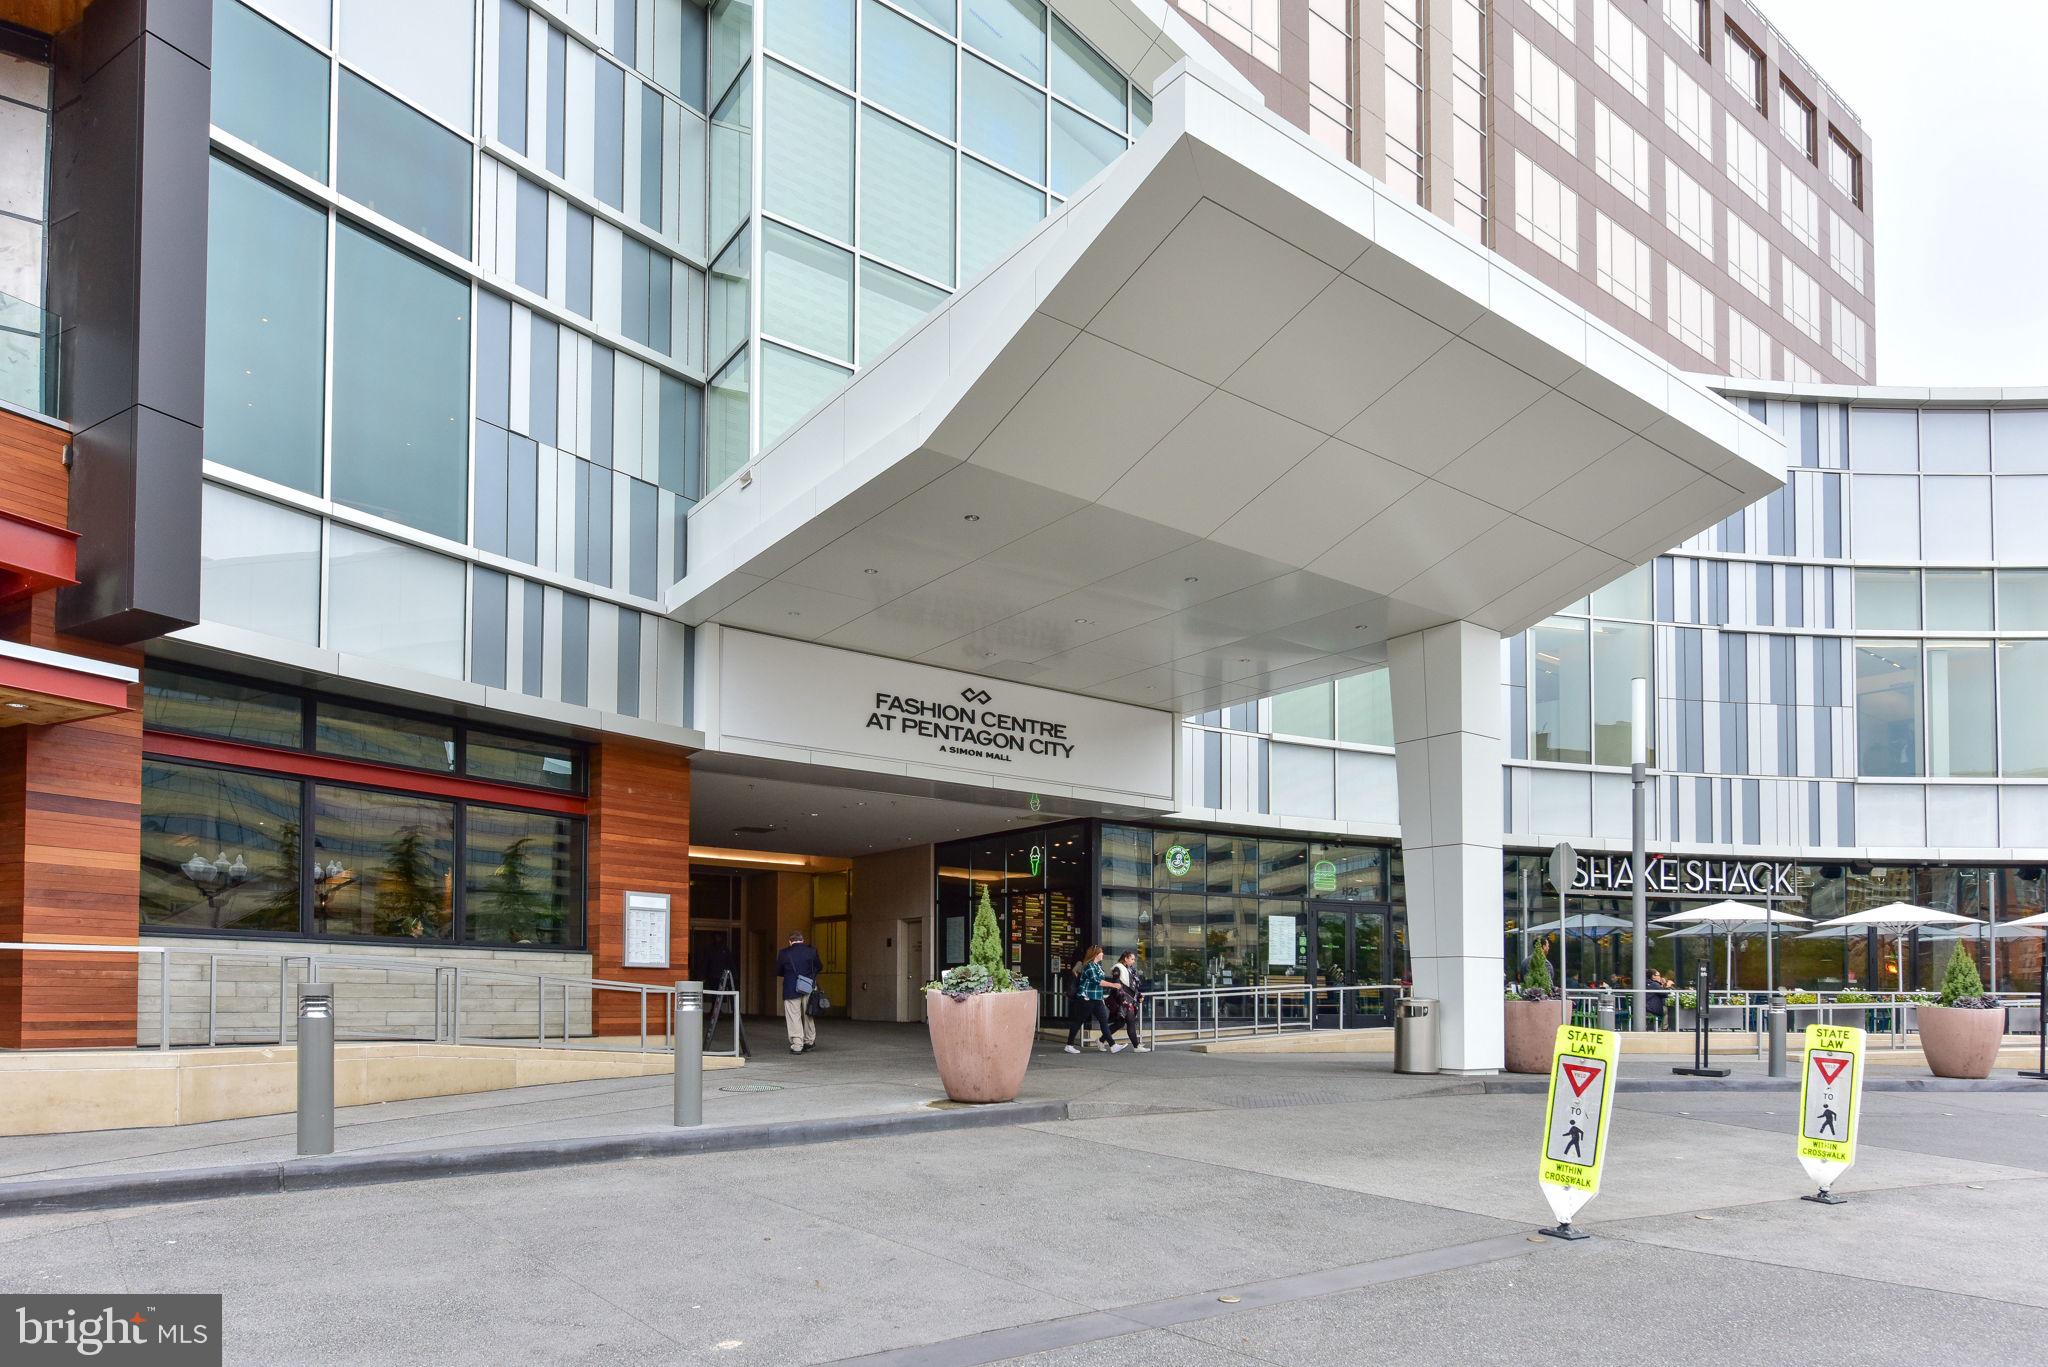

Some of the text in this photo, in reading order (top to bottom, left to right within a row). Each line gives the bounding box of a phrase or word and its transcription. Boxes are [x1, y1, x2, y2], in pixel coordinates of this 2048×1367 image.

[876, 692, 1067, 740] FASHION CENTRE
[866, 712, 1075, 759] AT PENTAGON CITY
[949, 746, 983, 758] SIMON
[985, 751, 1012, 762] MALL
[1572, 855, 1795, 894] SHAKE SHACK
[1567, 1030, 1604, 1044] STATE
[1816, 1028, 1850, 1039] STATE
[1571, 1043, 1597, 1055] LAW
[1820, 1039, 1844, 1049] LAW
[1823, 1092, 1834, 1101] TO
[1570, 1106, 1582, 1116] TO
[1812, 1141, 1838, 1151] WITHIN
[1802, 1147, 1846, 1160] CROSSWALK
[1556, 1163, 1583, 1176] WITHIN
[1544, 1171, 1592, 1187] CROSSWALK
